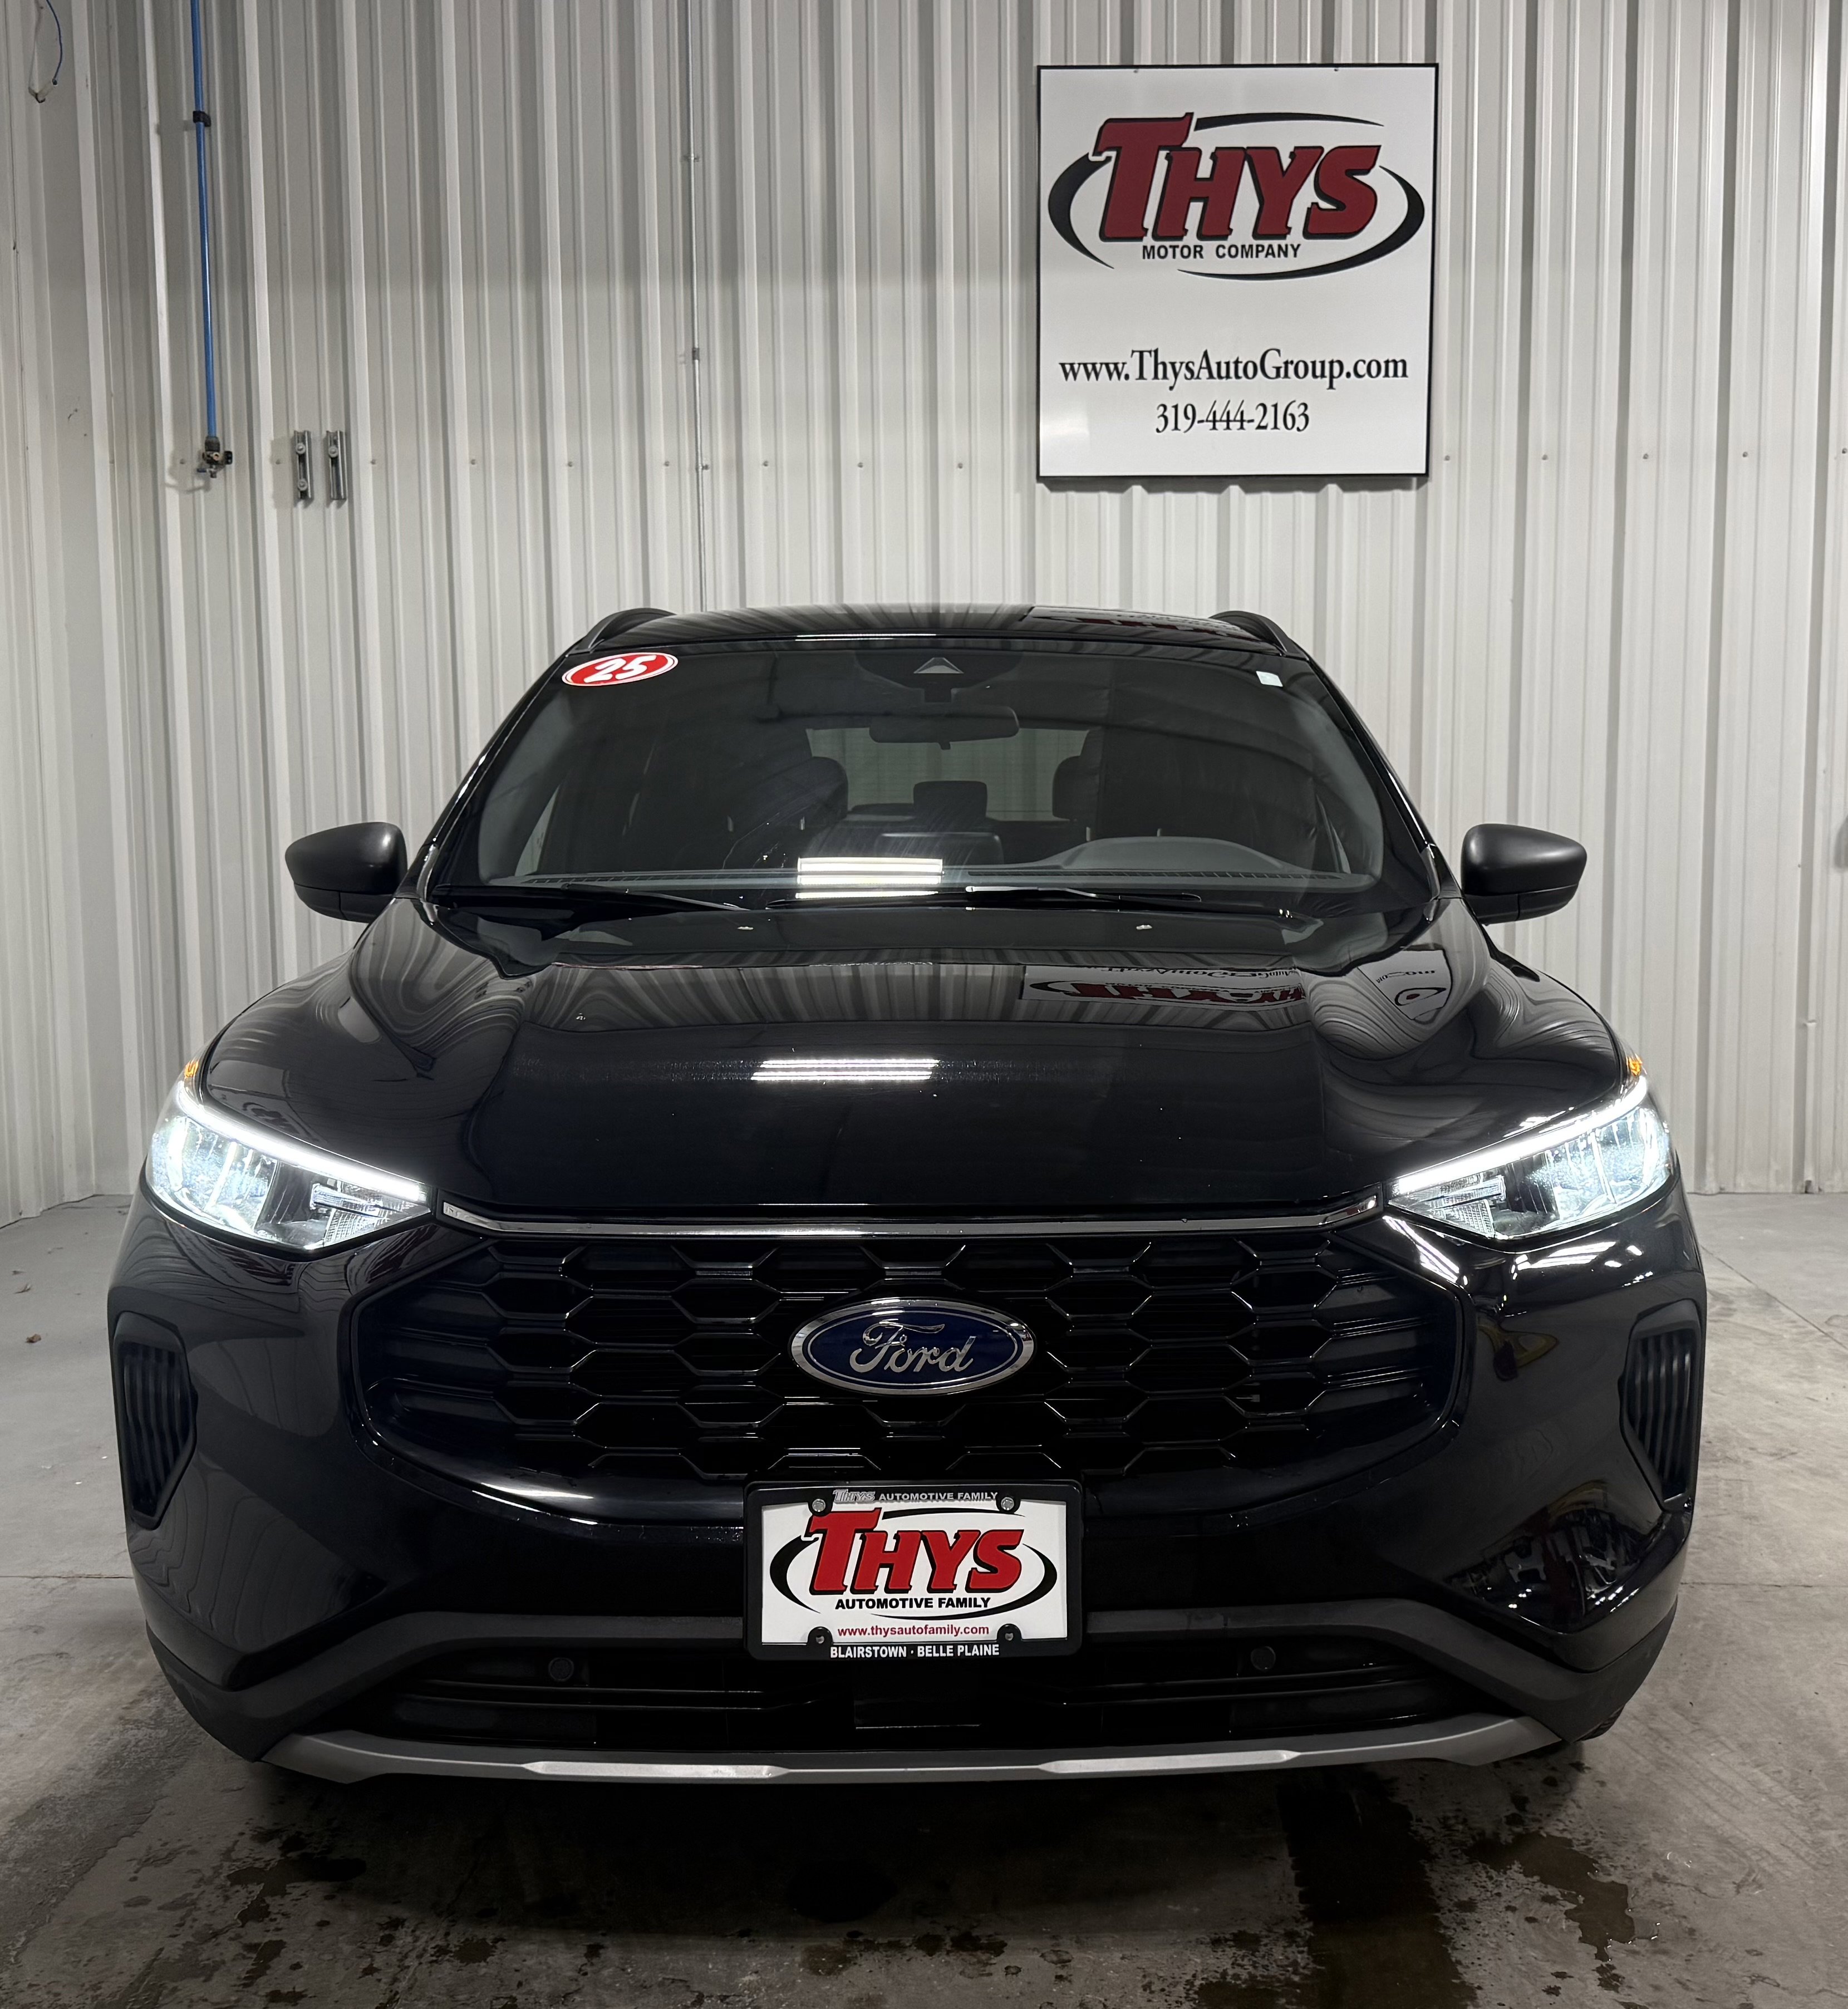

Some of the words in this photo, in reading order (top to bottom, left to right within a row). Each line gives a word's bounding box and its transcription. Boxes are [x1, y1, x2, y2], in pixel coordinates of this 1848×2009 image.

[1092, 112, 1382, 242] THYS
[1142, 244, 1204, 260] MOTOR
[1215, 243, 1302, 259] COMPANY
[1059, 348, 1409, 391] www.ThysAutoGroup.com
[1155, 400, 1310, 433] 319-444-2163
[583, 655, 657, 684] 25
[849, 1319, 977, 1373] Ford
[833, 1489, 876, 1504] THYS
[878, 1492, 954, 1501] AUTOMOTIVE
[957, 1492, 998, 1500] FAMILY
[804, 1507, 1025, 1595] THYS
[835, 1597, 933, 1610] AUTOMOTIVE
[938, 1597, 991, 1609] FAMILY
[837, 1624, 990, 1638] www.thysautofamily.com
[830, 1645, 907, 1658] BLAIRSTOWN
[917, 1645, 954, 1657] BELLE
[957, 1644, 1000, 1657] PLAINE
